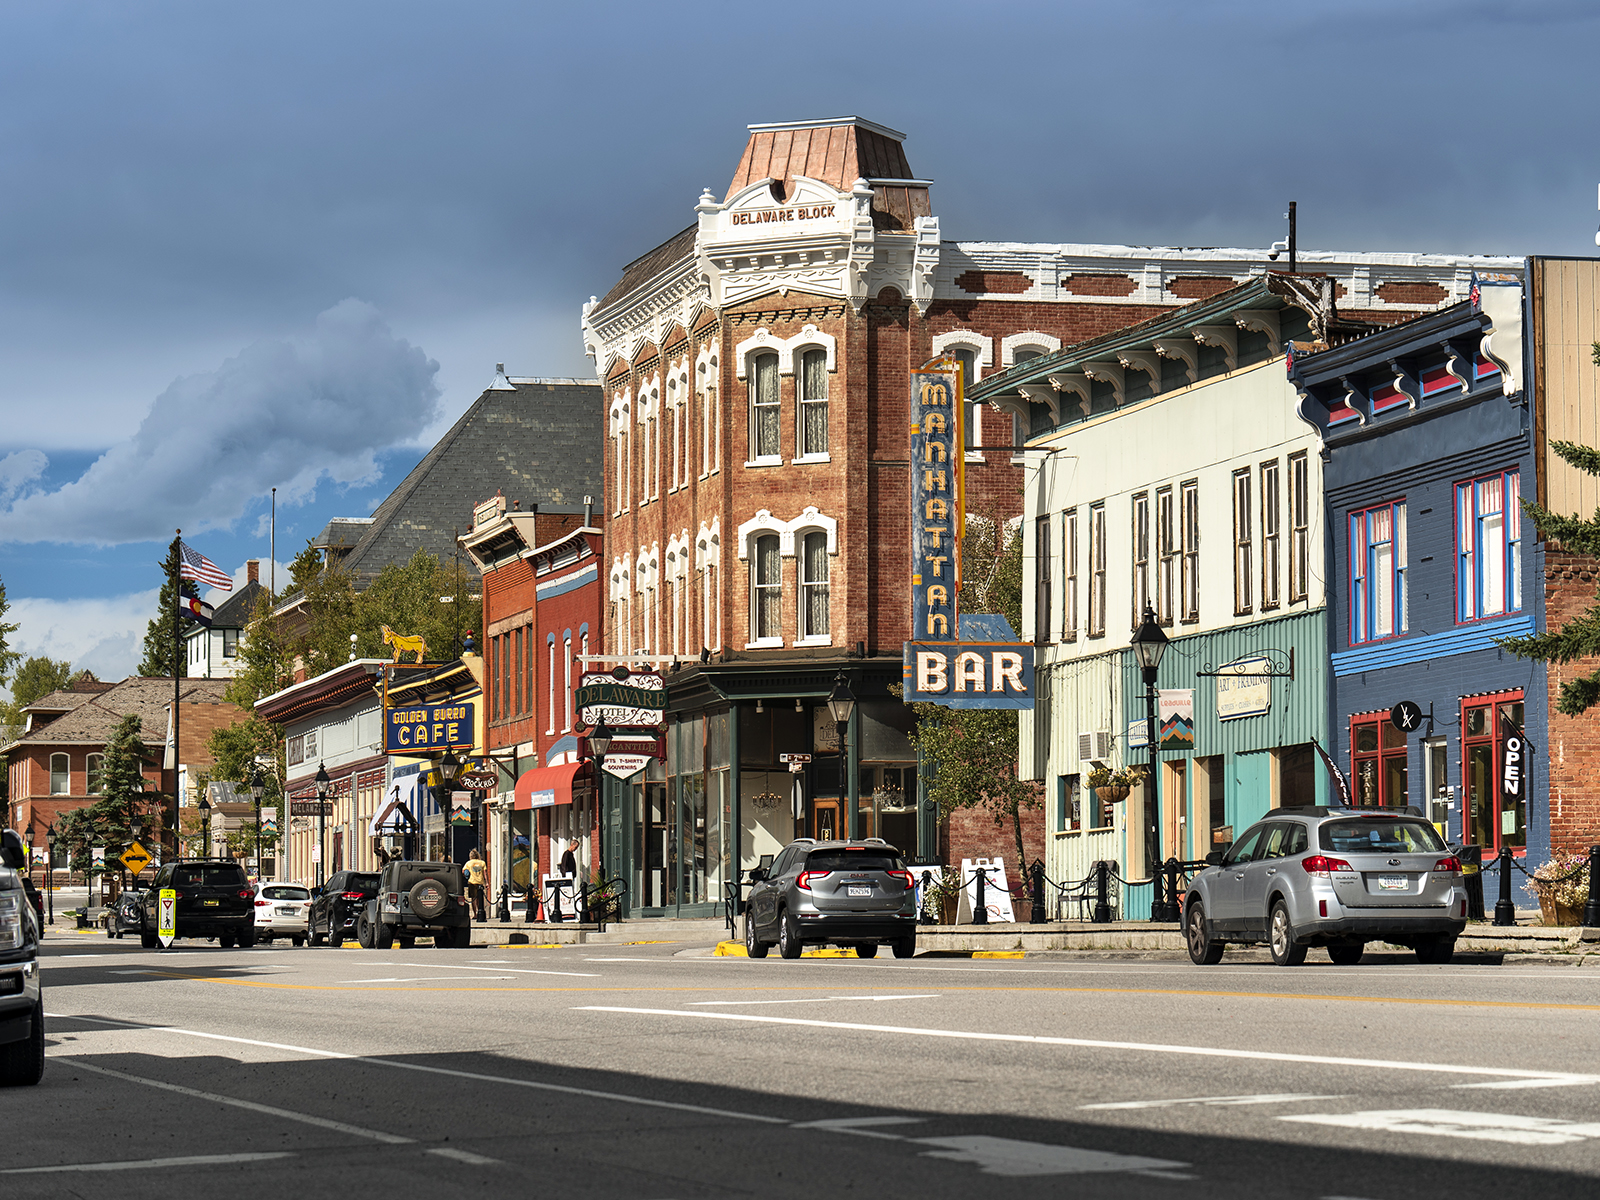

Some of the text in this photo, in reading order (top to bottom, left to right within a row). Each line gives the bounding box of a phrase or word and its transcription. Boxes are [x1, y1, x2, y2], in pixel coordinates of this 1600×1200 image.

[732, 205, 835, 225] DELAWARE BLOCK
[921, 383, 948, 635] MANHATTAN
[916, 651, 1027, 693] BAR
[578, 686, 666, 707] DELAWARE
[392, 707, 466, 724] GOLDEN BURRO
[595, 708, 629, 717] HOTEL
[397, 722, 459, 745] CAFE
[1129, 724, 1148, 740] GALLER
[1504, 737, 1521, 795] OPEN
